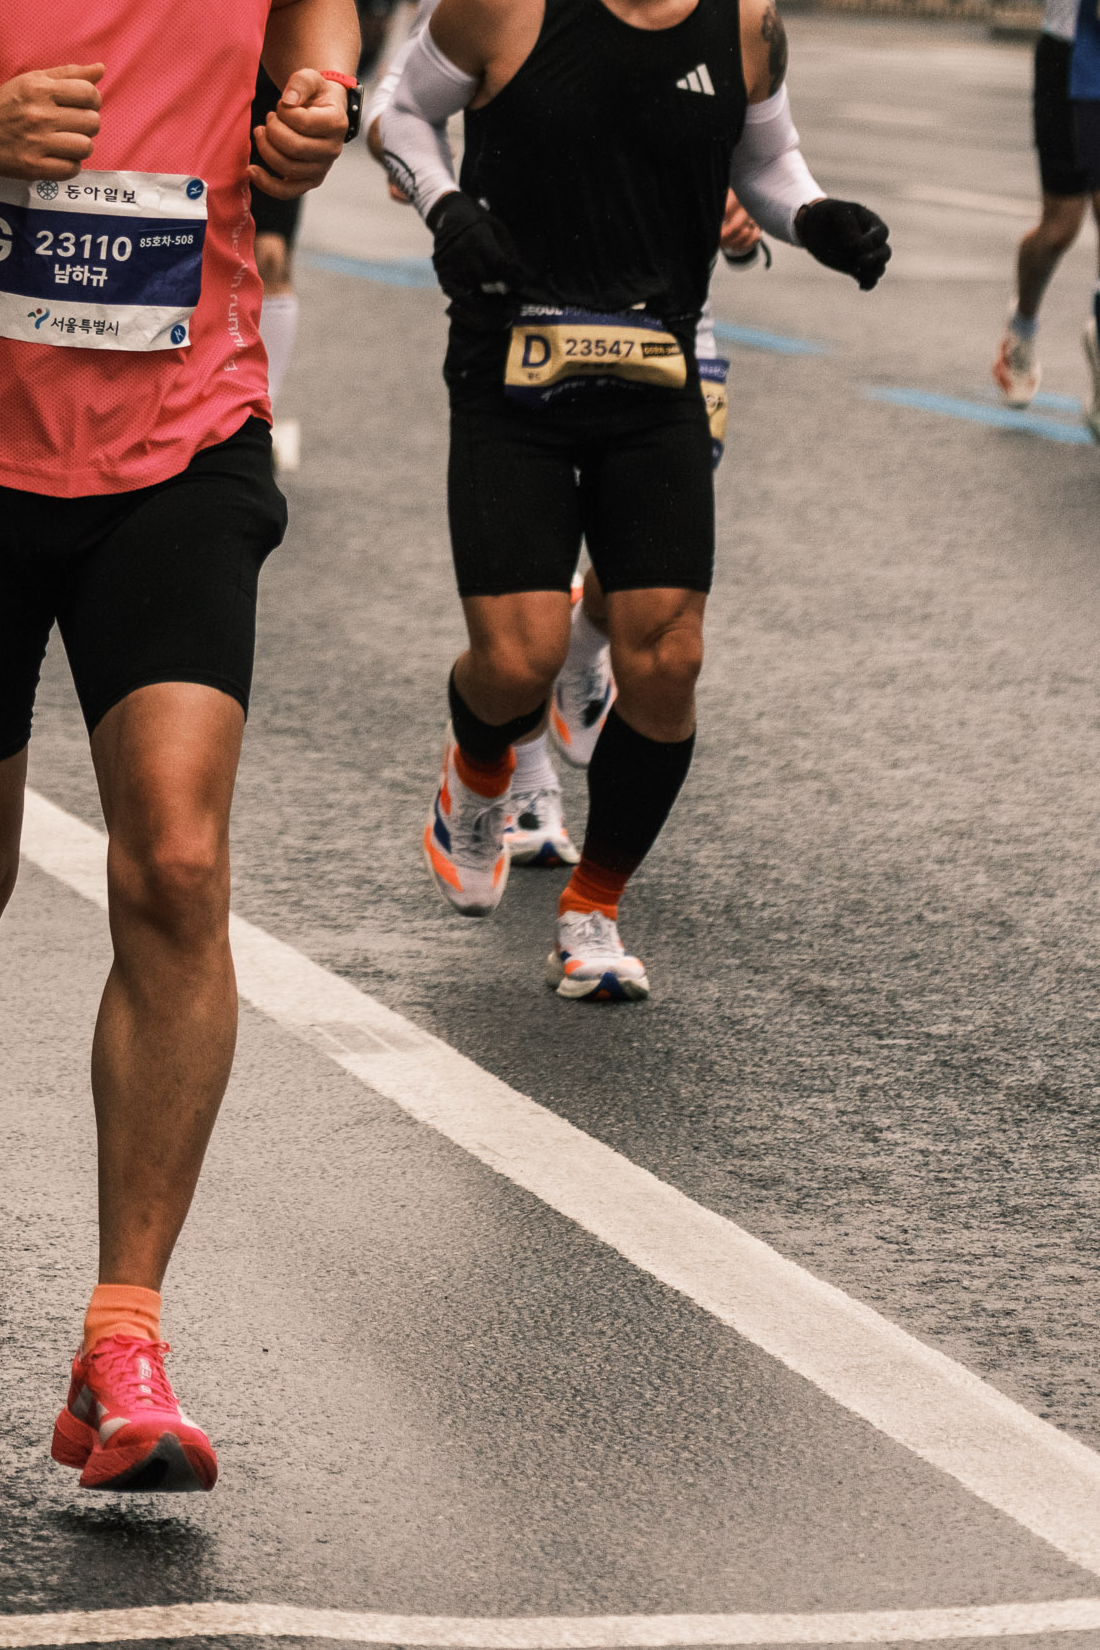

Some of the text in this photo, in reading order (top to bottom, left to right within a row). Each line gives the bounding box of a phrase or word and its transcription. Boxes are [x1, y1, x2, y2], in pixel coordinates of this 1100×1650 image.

[64, 184, 137, 204] 동아일보
[34, 230, 133, 262] 23110
[139, 234, 194, 248] 85호차-508
[53, 264, 109, 288] 남하규
[50, 316, 120, 336] 서울특별시
[521, 334, 552, 368] D
[565, 338, 635, 358] 23547
